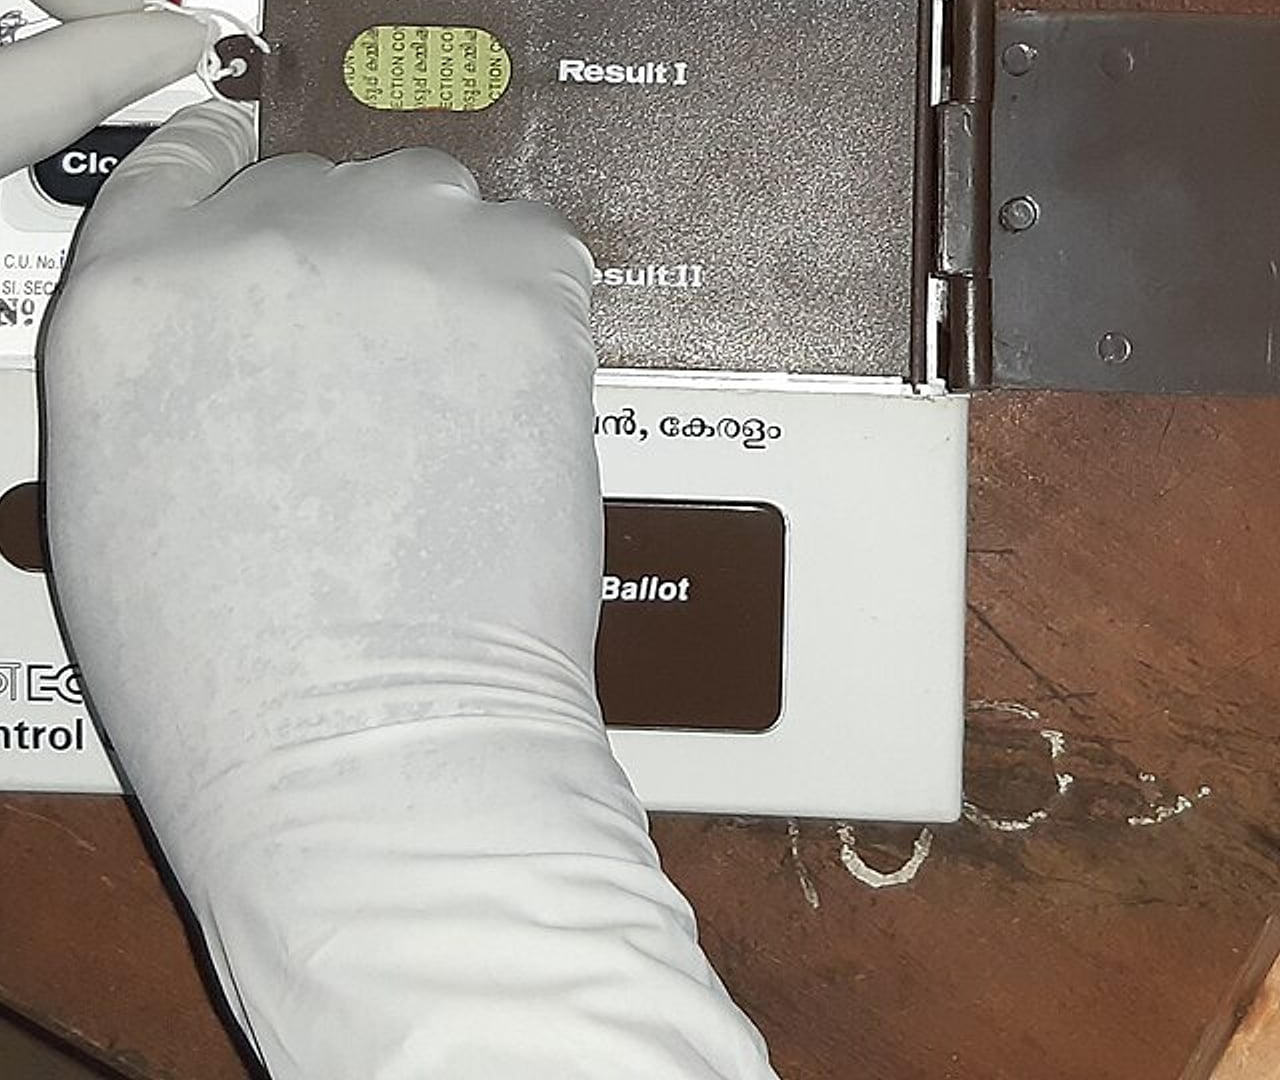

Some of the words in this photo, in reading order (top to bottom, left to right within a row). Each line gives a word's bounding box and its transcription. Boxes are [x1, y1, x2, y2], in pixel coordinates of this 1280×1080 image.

[391, 56, 404, 108] ECTION
[440, 56, 453, 108] ECTION
[489, 57, 502, 100] CTION
[559, 60, 668, 83] Result
[674, 62, 688, 86] I
[62, 151, 118, 174] Clo
[24, 280, 54, 296] SEC
[659, 416, 781, 449] കേരളം
[602, 576, 690, 601] Ballot
[27, 664, 83, 704] EC
